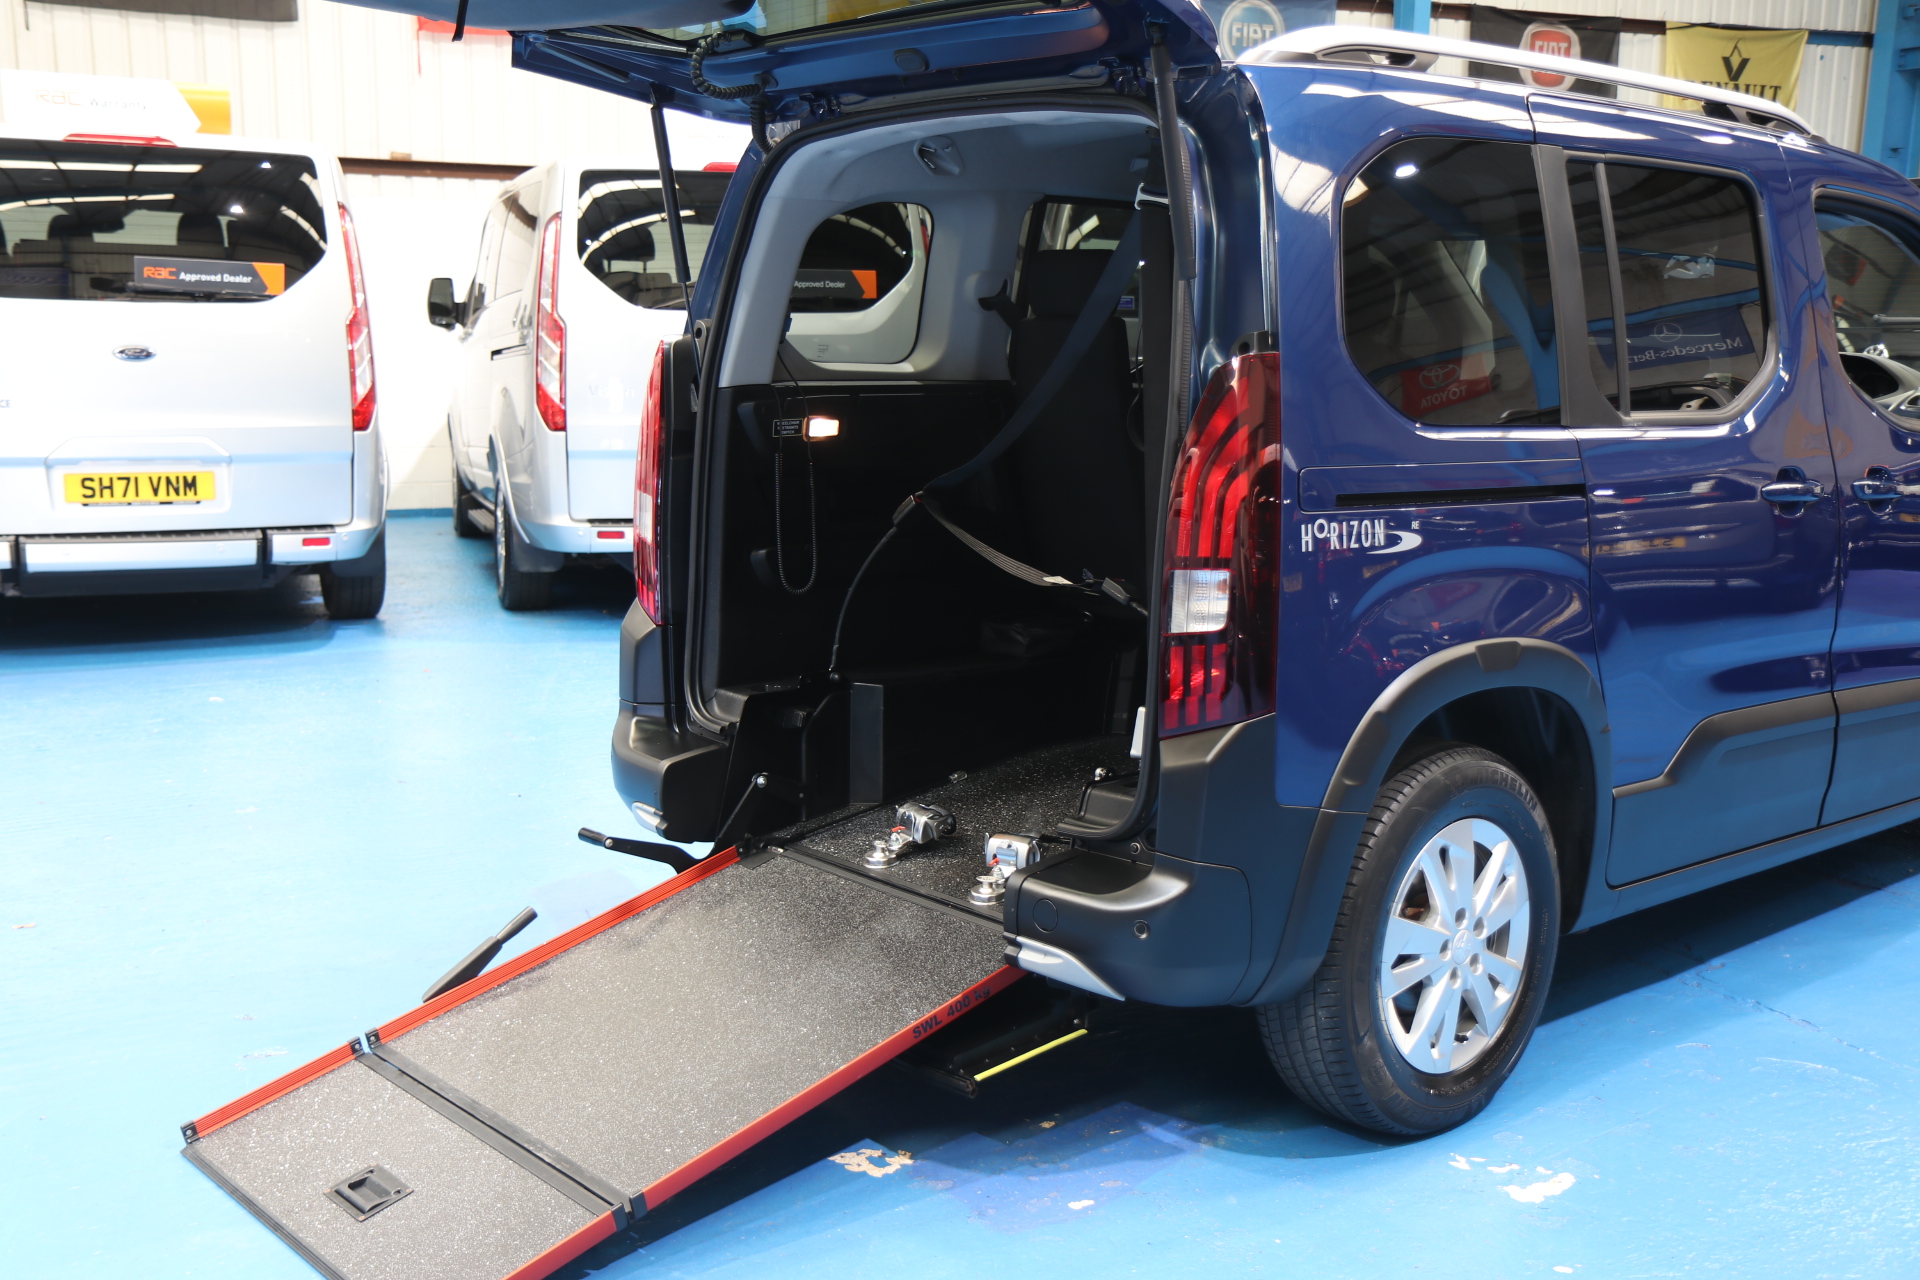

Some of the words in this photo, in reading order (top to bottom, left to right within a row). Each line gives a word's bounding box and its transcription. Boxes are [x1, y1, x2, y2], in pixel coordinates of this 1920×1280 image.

[1231, 22, 1274, 48] FIAT
[179, 271, 221, 283] Approved
[223, 273, 252, 283] Dealer
[793, 280, 824, 289] Approved
[825, 281, 846, 289] Dealer
[81, 476, 139, 498] SH71
[149, 475, 198, 497] VNM
[1301, 519, 1385, 552] HORIZON
[1411, 521, 1420, 530] RE
[912, 1015, 943, 1039] SWL
[947, 995, 971, 1017] 400
[973, 986, 991, 1001] kg
